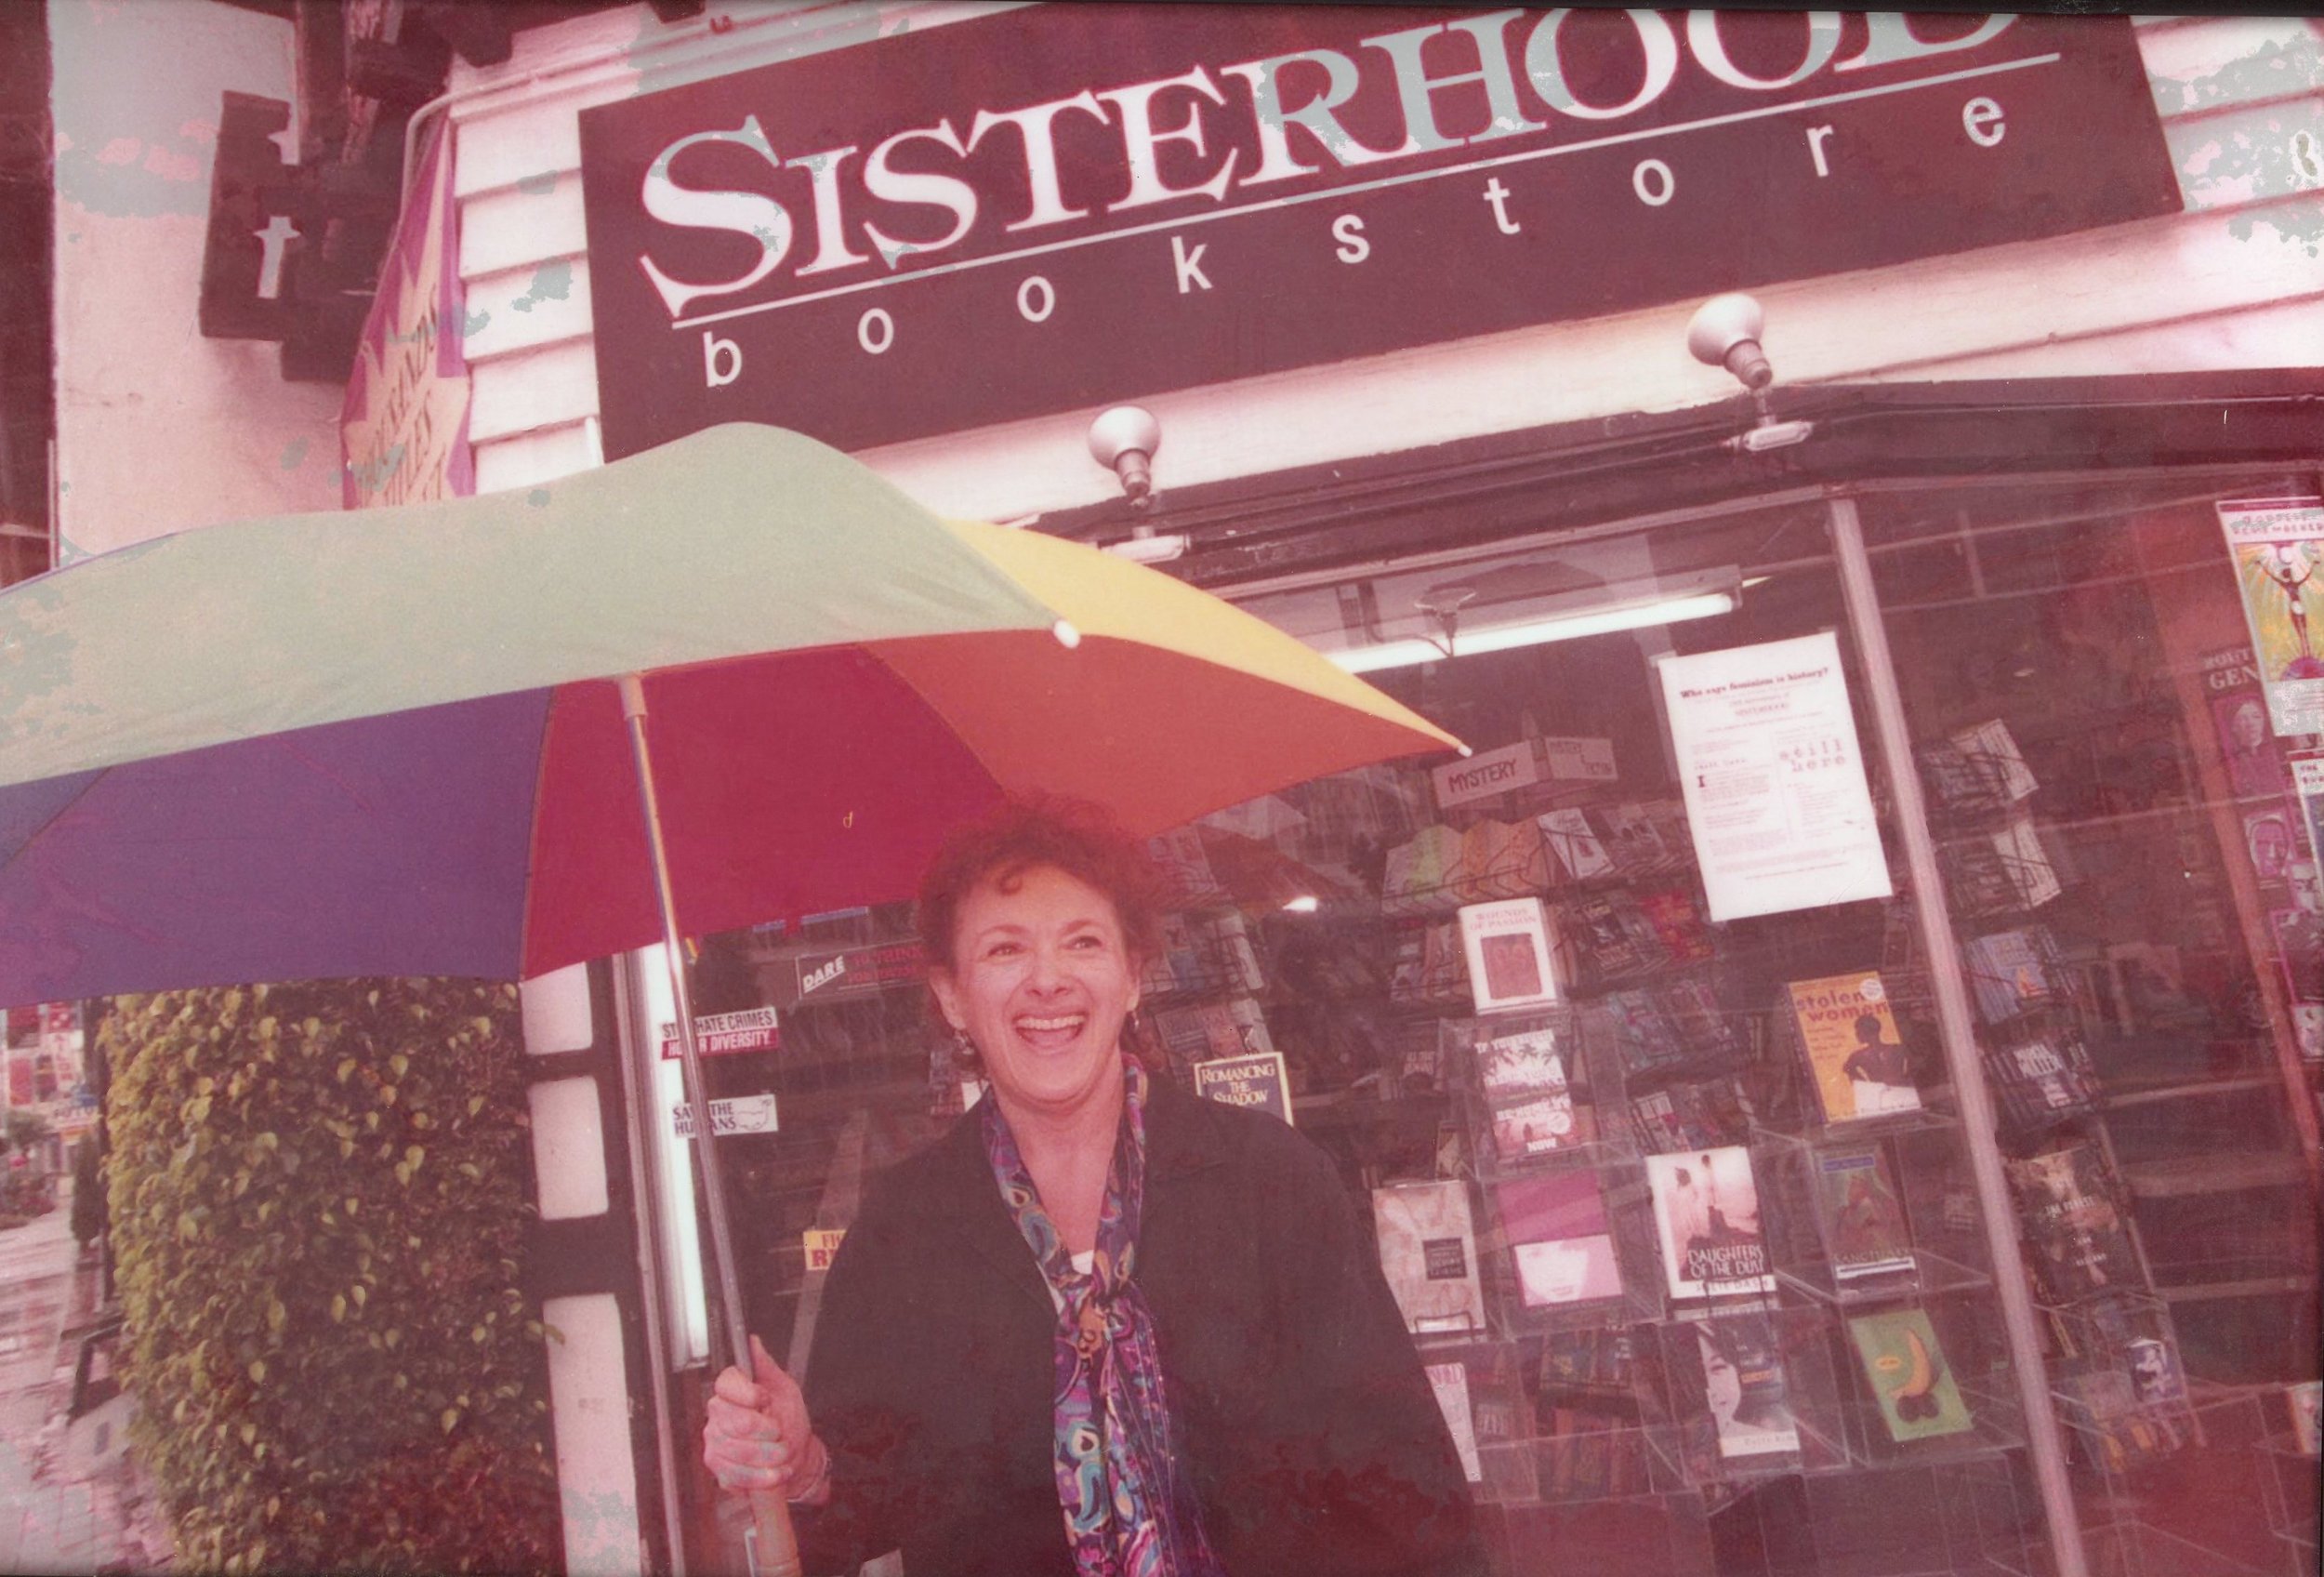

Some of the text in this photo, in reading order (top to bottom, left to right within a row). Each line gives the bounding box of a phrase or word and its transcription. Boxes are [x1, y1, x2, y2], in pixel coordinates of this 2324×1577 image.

[703, 96, 2005, 387] bookstore
[1680, 688, 1703, 699] Who
[1707, 684, 1726, 696] says
[1730, 677, 1774, 690] feminism
[1788, 667, 1829, 682] history?
[1448, 759, 1516, 793] MYSTERY
[803, 956, 845, 989] DARE
[1796, 989, 1865, 1012] stolen
[1808, 1001, 1889, 1022] women
[695, 1015, 724, 1034] HATE
[728, 1011, 772, 1030] CRIMES
[1202, 1063, 1274, 1084] ROMANCING
[1230, 1080, 1251, 1093] THE
[1213, 1089, 1268, 1106] SHADOW
[710, 1102, 733, 1116] THE
[675, 1118, 736, 1134] HUANS
[1527, 1138, 1557, 1152] NOW
[1687, 1244, 1763, 1265] DAUGHTERS
[1690, 1258, 1764, 1279] OF THE DUST
